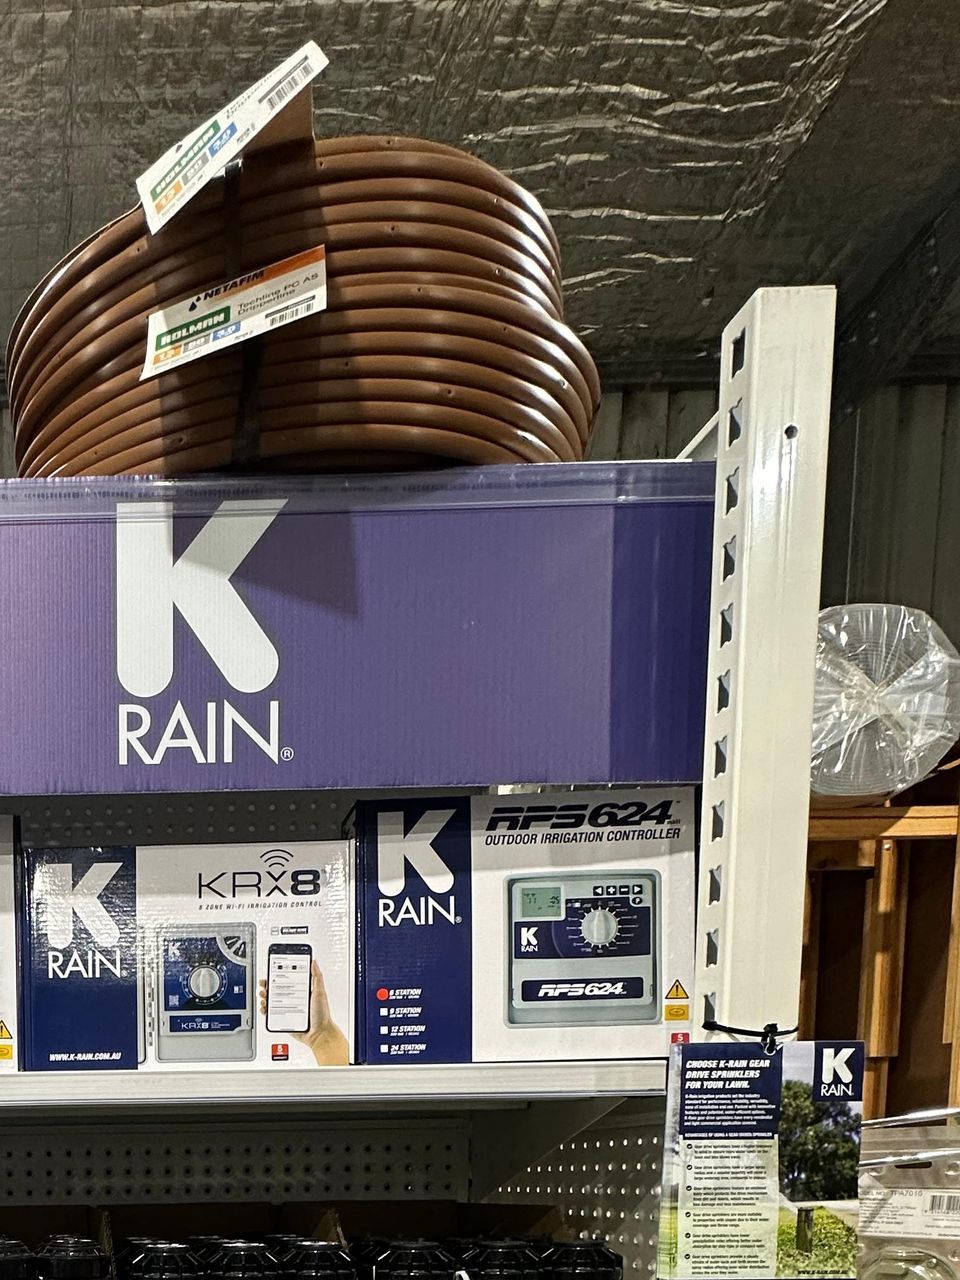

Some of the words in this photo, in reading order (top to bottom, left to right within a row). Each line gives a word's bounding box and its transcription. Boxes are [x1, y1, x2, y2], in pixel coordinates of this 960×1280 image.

[204, 270, 264, 300] NETAFIM
[161, 313, 224, 346] HOLMAN
[116, 499, 289, 697] K
[485, 800, 673, 831] RPS624
[485, 834, 537, 846] OUTDOOR
[541, 831, 604, 844] IRRIGATION
[607, 828, 680, 842] CONTROLLER
[378, 809, 457, 897] K
[198, 869, 321, 899] KRX8
[46, 863, 124, 949] K
[379, 895, 455, 927] RAIN
[48, 950, 122, 979] RAIN
[538, 982, 623, 997] RPS624
[49, 1052, 122, 1061] WWW.K-RAIN.COM.AU
[686, 1060, 718, 1068] CHOOSE
[822, 1048, 855, 1084] K
[711, 1070, 760, 1078] SPRINKLERS
[821, 1085, 853, 1096] RAIN
